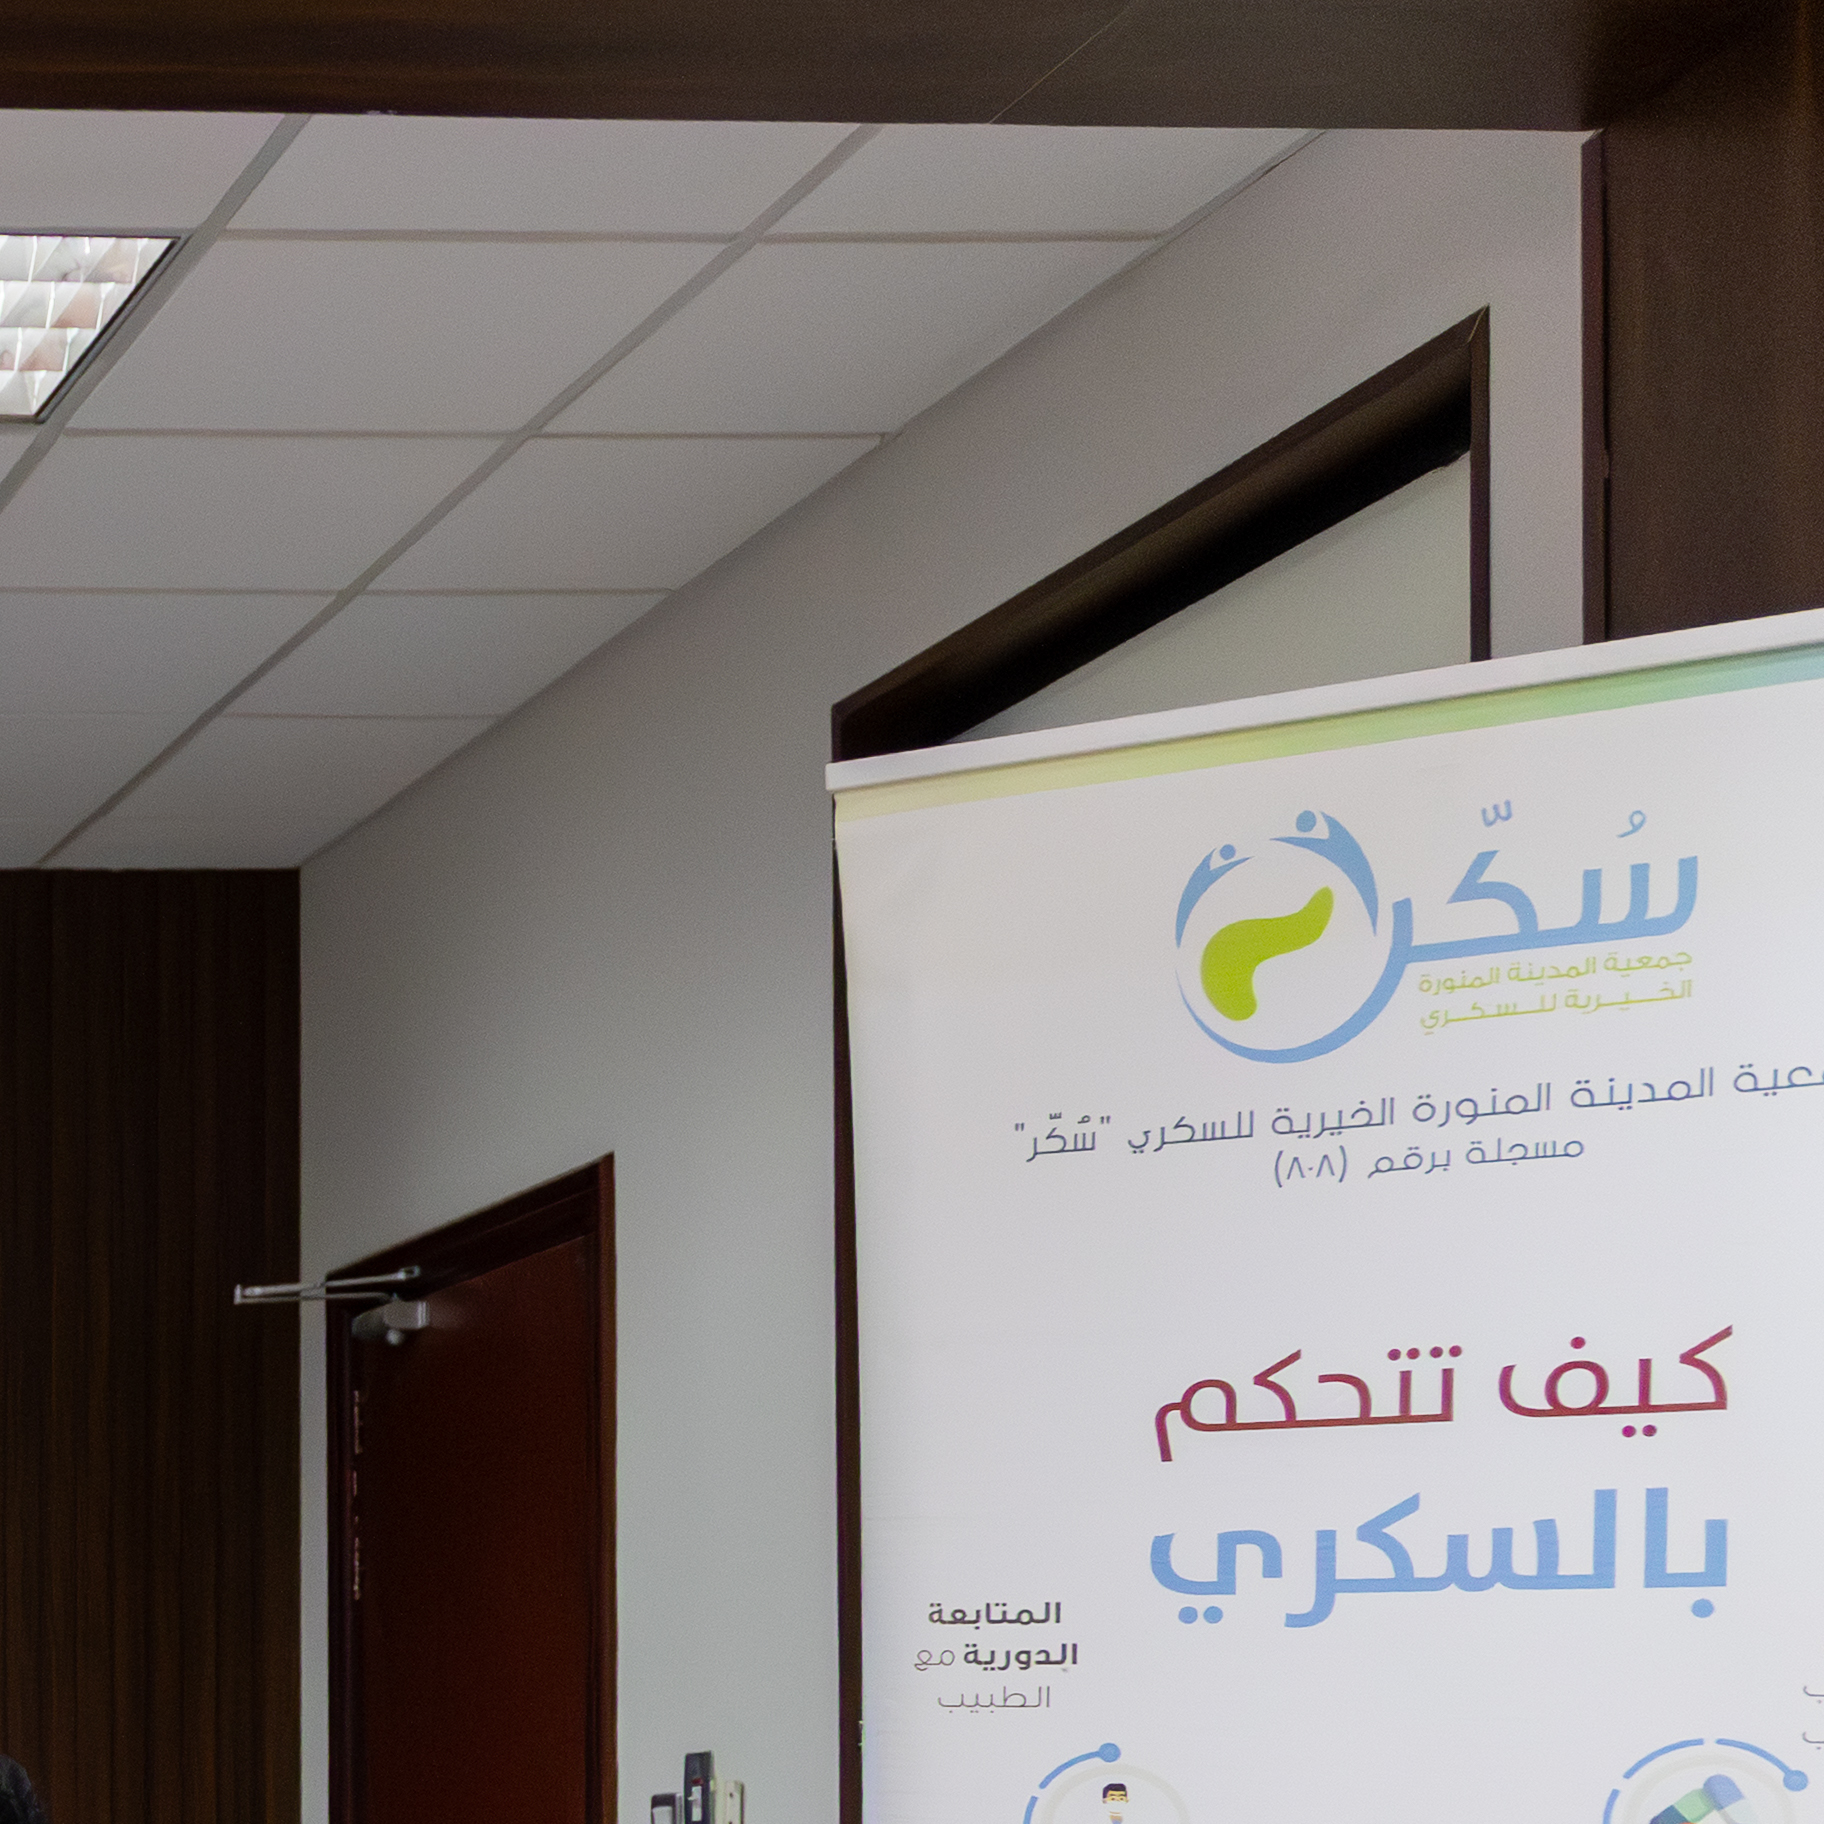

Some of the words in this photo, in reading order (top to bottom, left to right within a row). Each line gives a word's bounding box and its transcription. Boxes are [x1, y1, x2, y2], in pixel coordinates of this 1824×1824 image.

[1418, 965, 1501, 995] المنورة
[1507, 955, 1597, 985] المدينة
[1603, 951, 1693, 976] جمعية
[1420, 995, 1557, 1036] للسكري
[1570, 1066, 1714, 1111] المدينة
[1733, 1063, 1824, 1098] عية
[1271, 1096, 1394, 1140] الخيرية
[1412, 1082, 1551, 1128] المنورة
[1127, 1110, 1254, 1154] للسكري
[1368, 1146, 1451, 1179] برقم
[1465, 1137, 1584, 1166] مسجلة
[1498, 1324, 1734, 1438] كيف
[1153, 1344, 1464, 1463] تتحكم
[1151, 1486, 1729, 1629] بالسكري
[928, 1601, 1062, 1630] المتابعة
[914, 1649, 956, 1671] مع
[963, 1643, 1078, 1671] الدورية
[937, 1686, 1050, 1714] الطبيب
